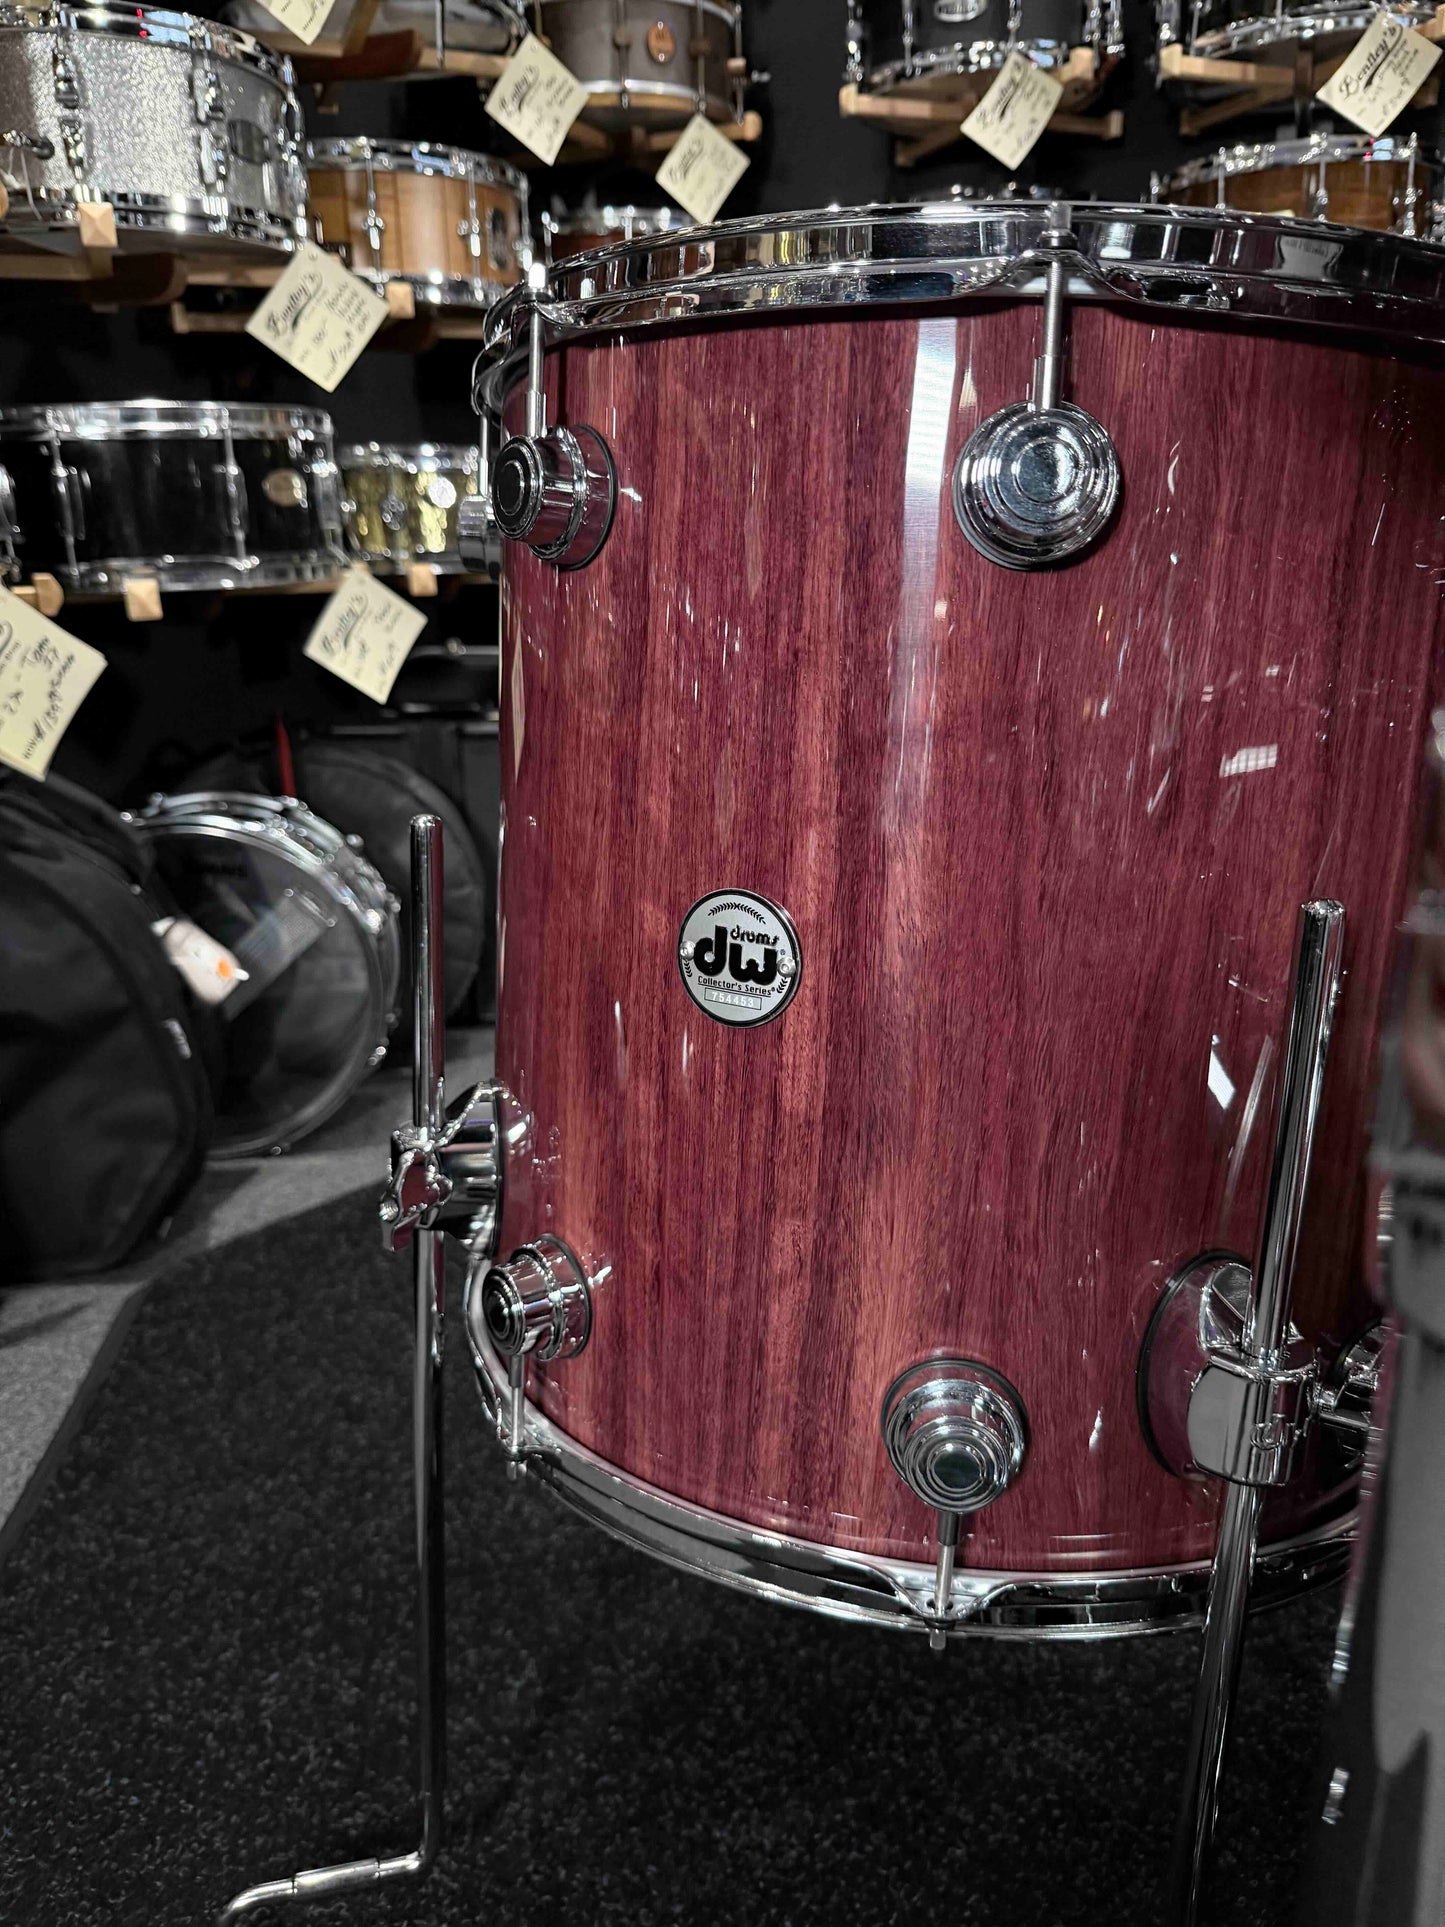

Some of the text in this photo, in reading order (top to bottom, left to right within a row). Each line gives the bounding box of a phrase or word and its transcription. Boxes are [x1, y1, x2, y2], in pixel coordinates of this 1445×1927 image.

[1338, 26, 1403, 100] Bentley's
[693, 925, 778, 986] dw
[730, 924, 780, 946] drums
[698, 975, 742, 991] Collector's
